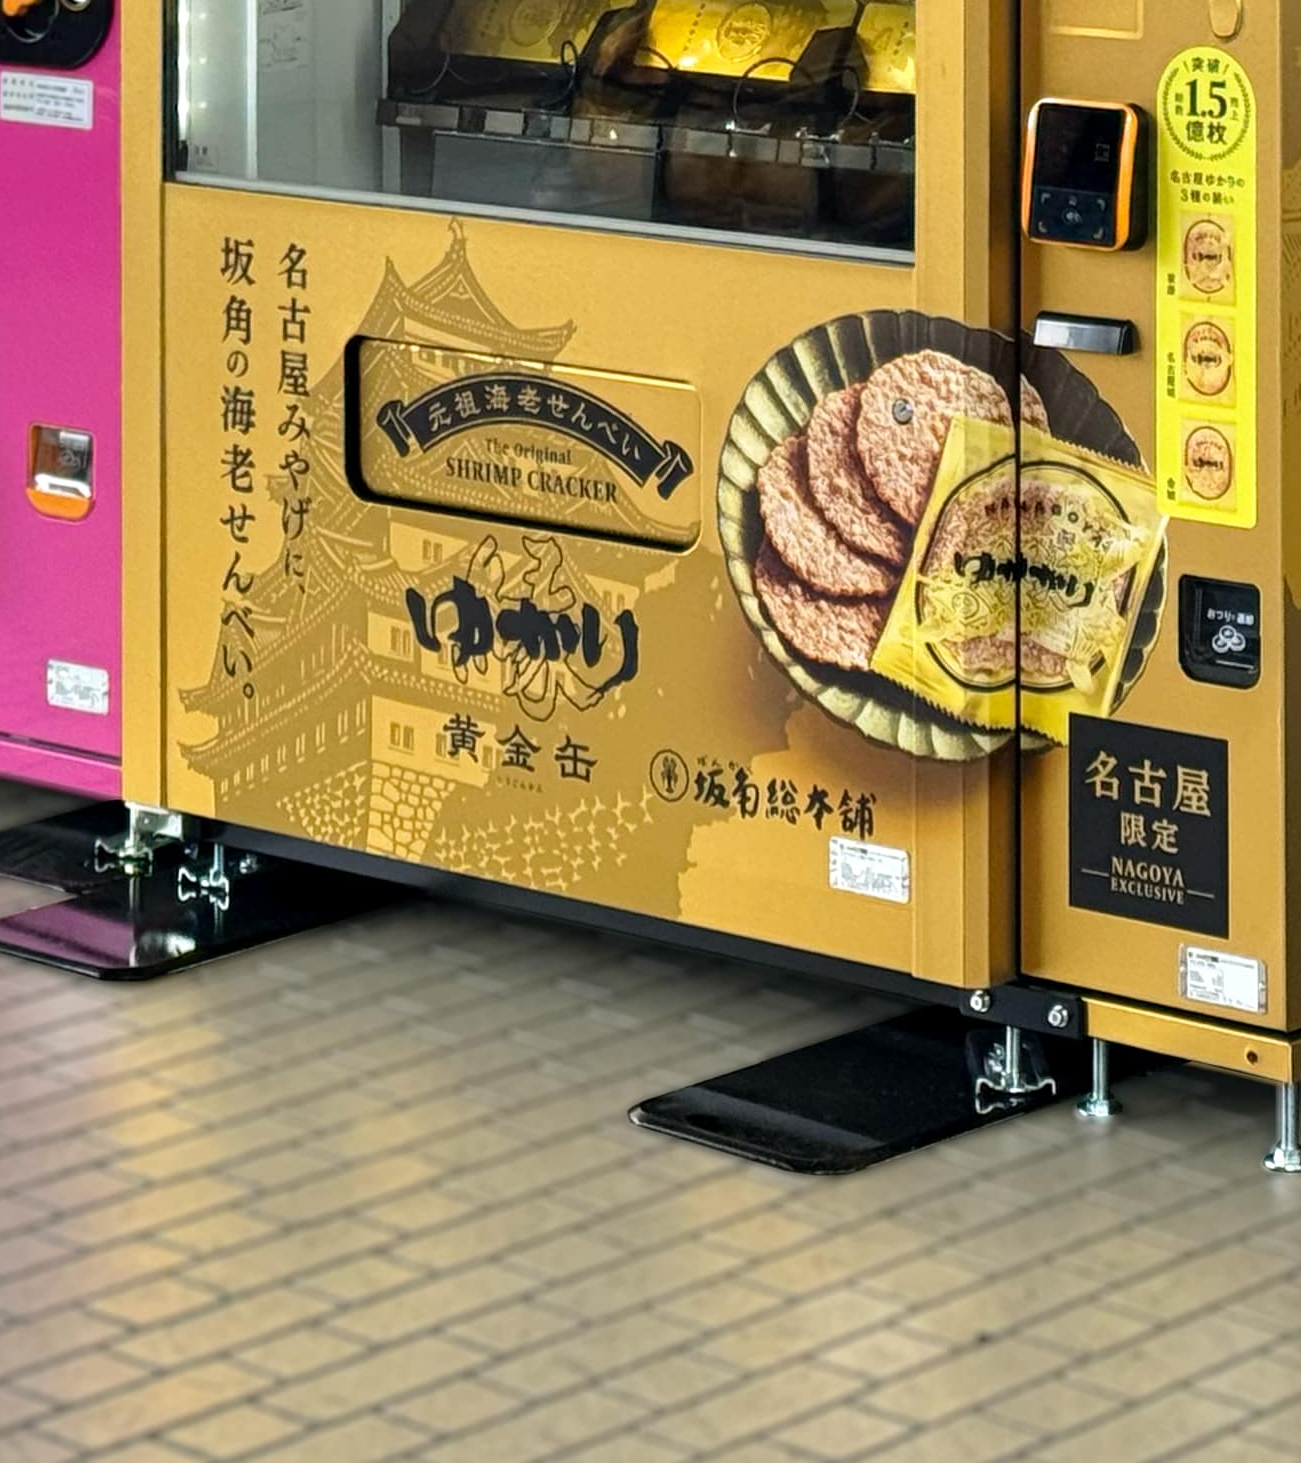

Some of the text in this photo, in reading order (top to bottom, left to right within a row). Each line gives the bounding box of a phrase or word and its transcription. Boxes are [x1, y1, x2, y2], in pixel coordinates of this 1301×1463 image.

[1185, 78, 1228, 119] 1.5
[276, 241, 313, 595] 名古屋みやげに、
[426, 384, 642, 461] 元祖海老せんべい
[218, 236, 256, 701] 坂角の海老せんべい。
[485, 437, 572, 467] The Original
[445, 457, 618, 504] SHRIMP CRACKER
[442, 712, 598, 783] 黄金缶
[1084, 750, 1212, 819] 名古屋
[1119, 810, 1180, 855] 限定
[1109, 877, 1185, 906] EXCLUSIVE
[1110, 855, 1185, 888] NAGOYA
